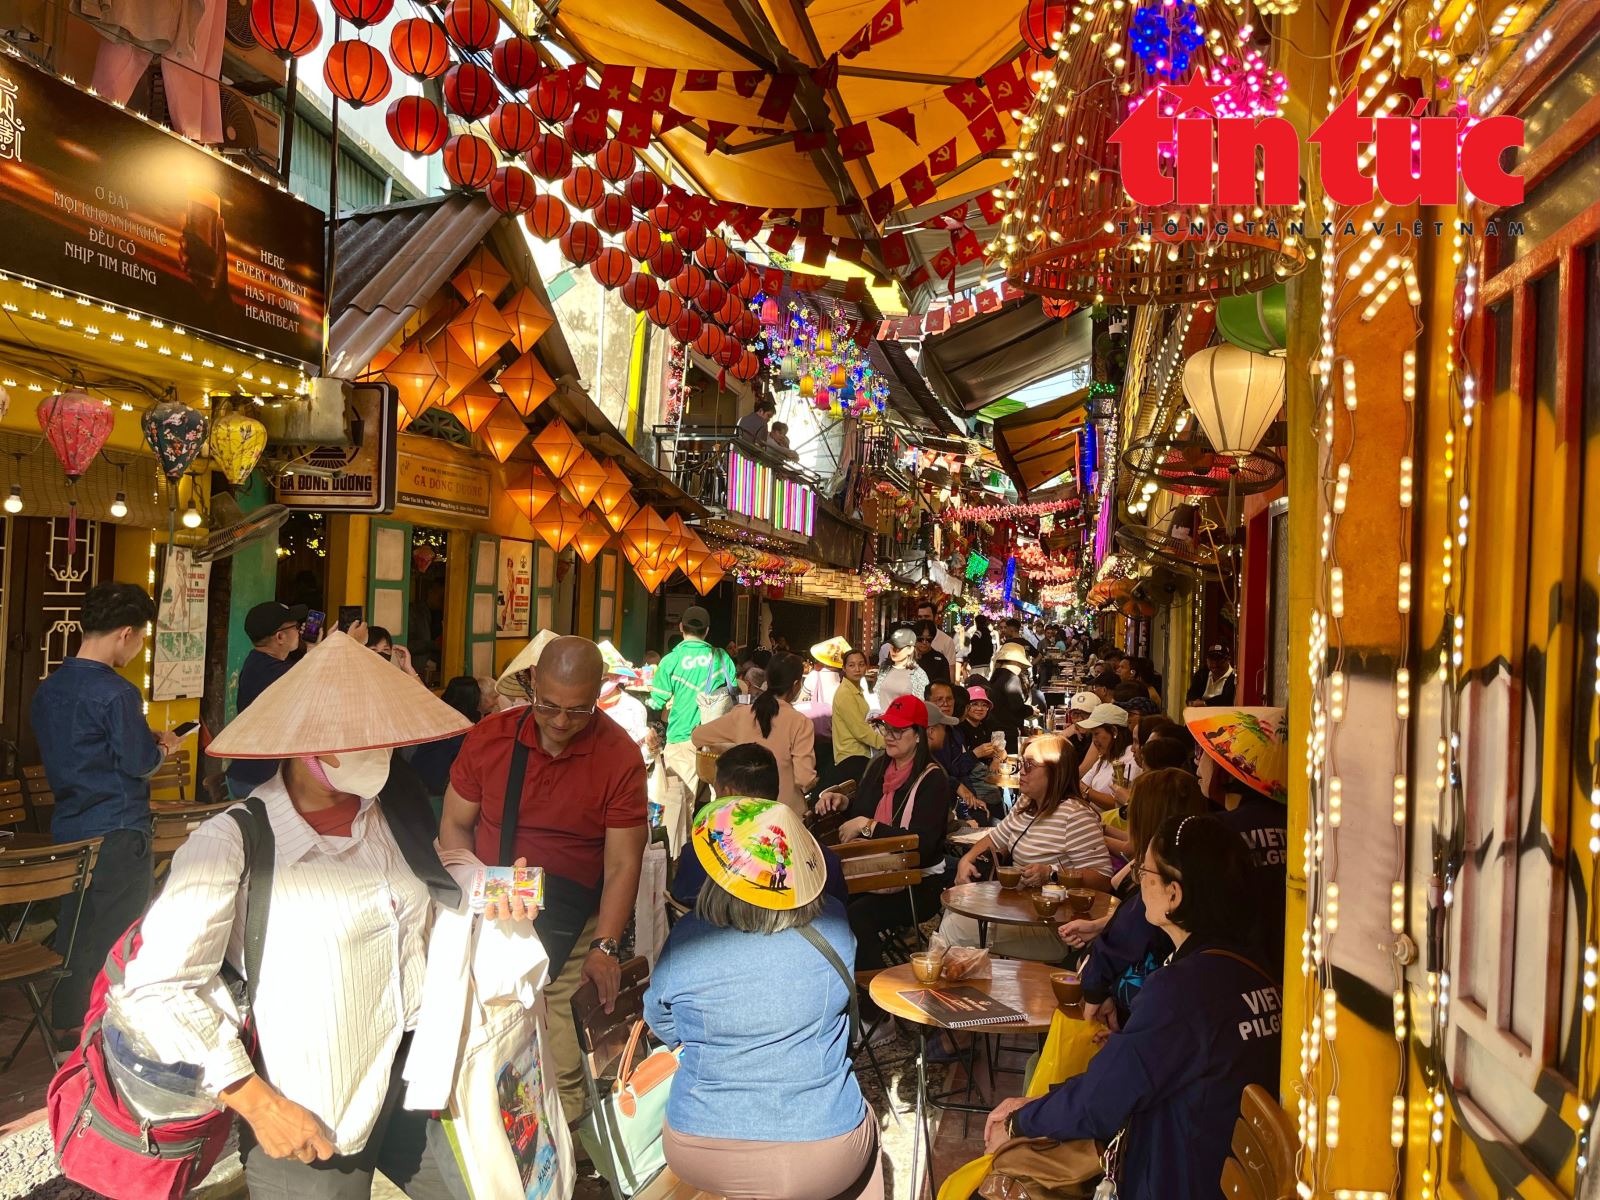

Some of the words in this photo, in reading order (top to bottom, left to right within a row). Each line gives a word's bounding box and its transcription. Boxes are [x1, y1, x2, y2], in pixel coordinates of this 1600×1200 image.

[54, 191, 77, 213] MỌI
[65, 241, 95, 265] NHỊP
[97, 253, 118, 272] TIM
[121, 261, 157, 286] RIÊNG
[118, 240, 136, 256] CÓ
[260, 249, 286, 271] HERE
[236, 260, 268, 282] EVERY
[269, 273, 308, 298] MOMENT
[245, 284, 265, 302] HAS
[267, 292, 276, 306] IT
[278, 297, 300, 315] OWN
[245, 303, 300, 334] HEARTBEAT
